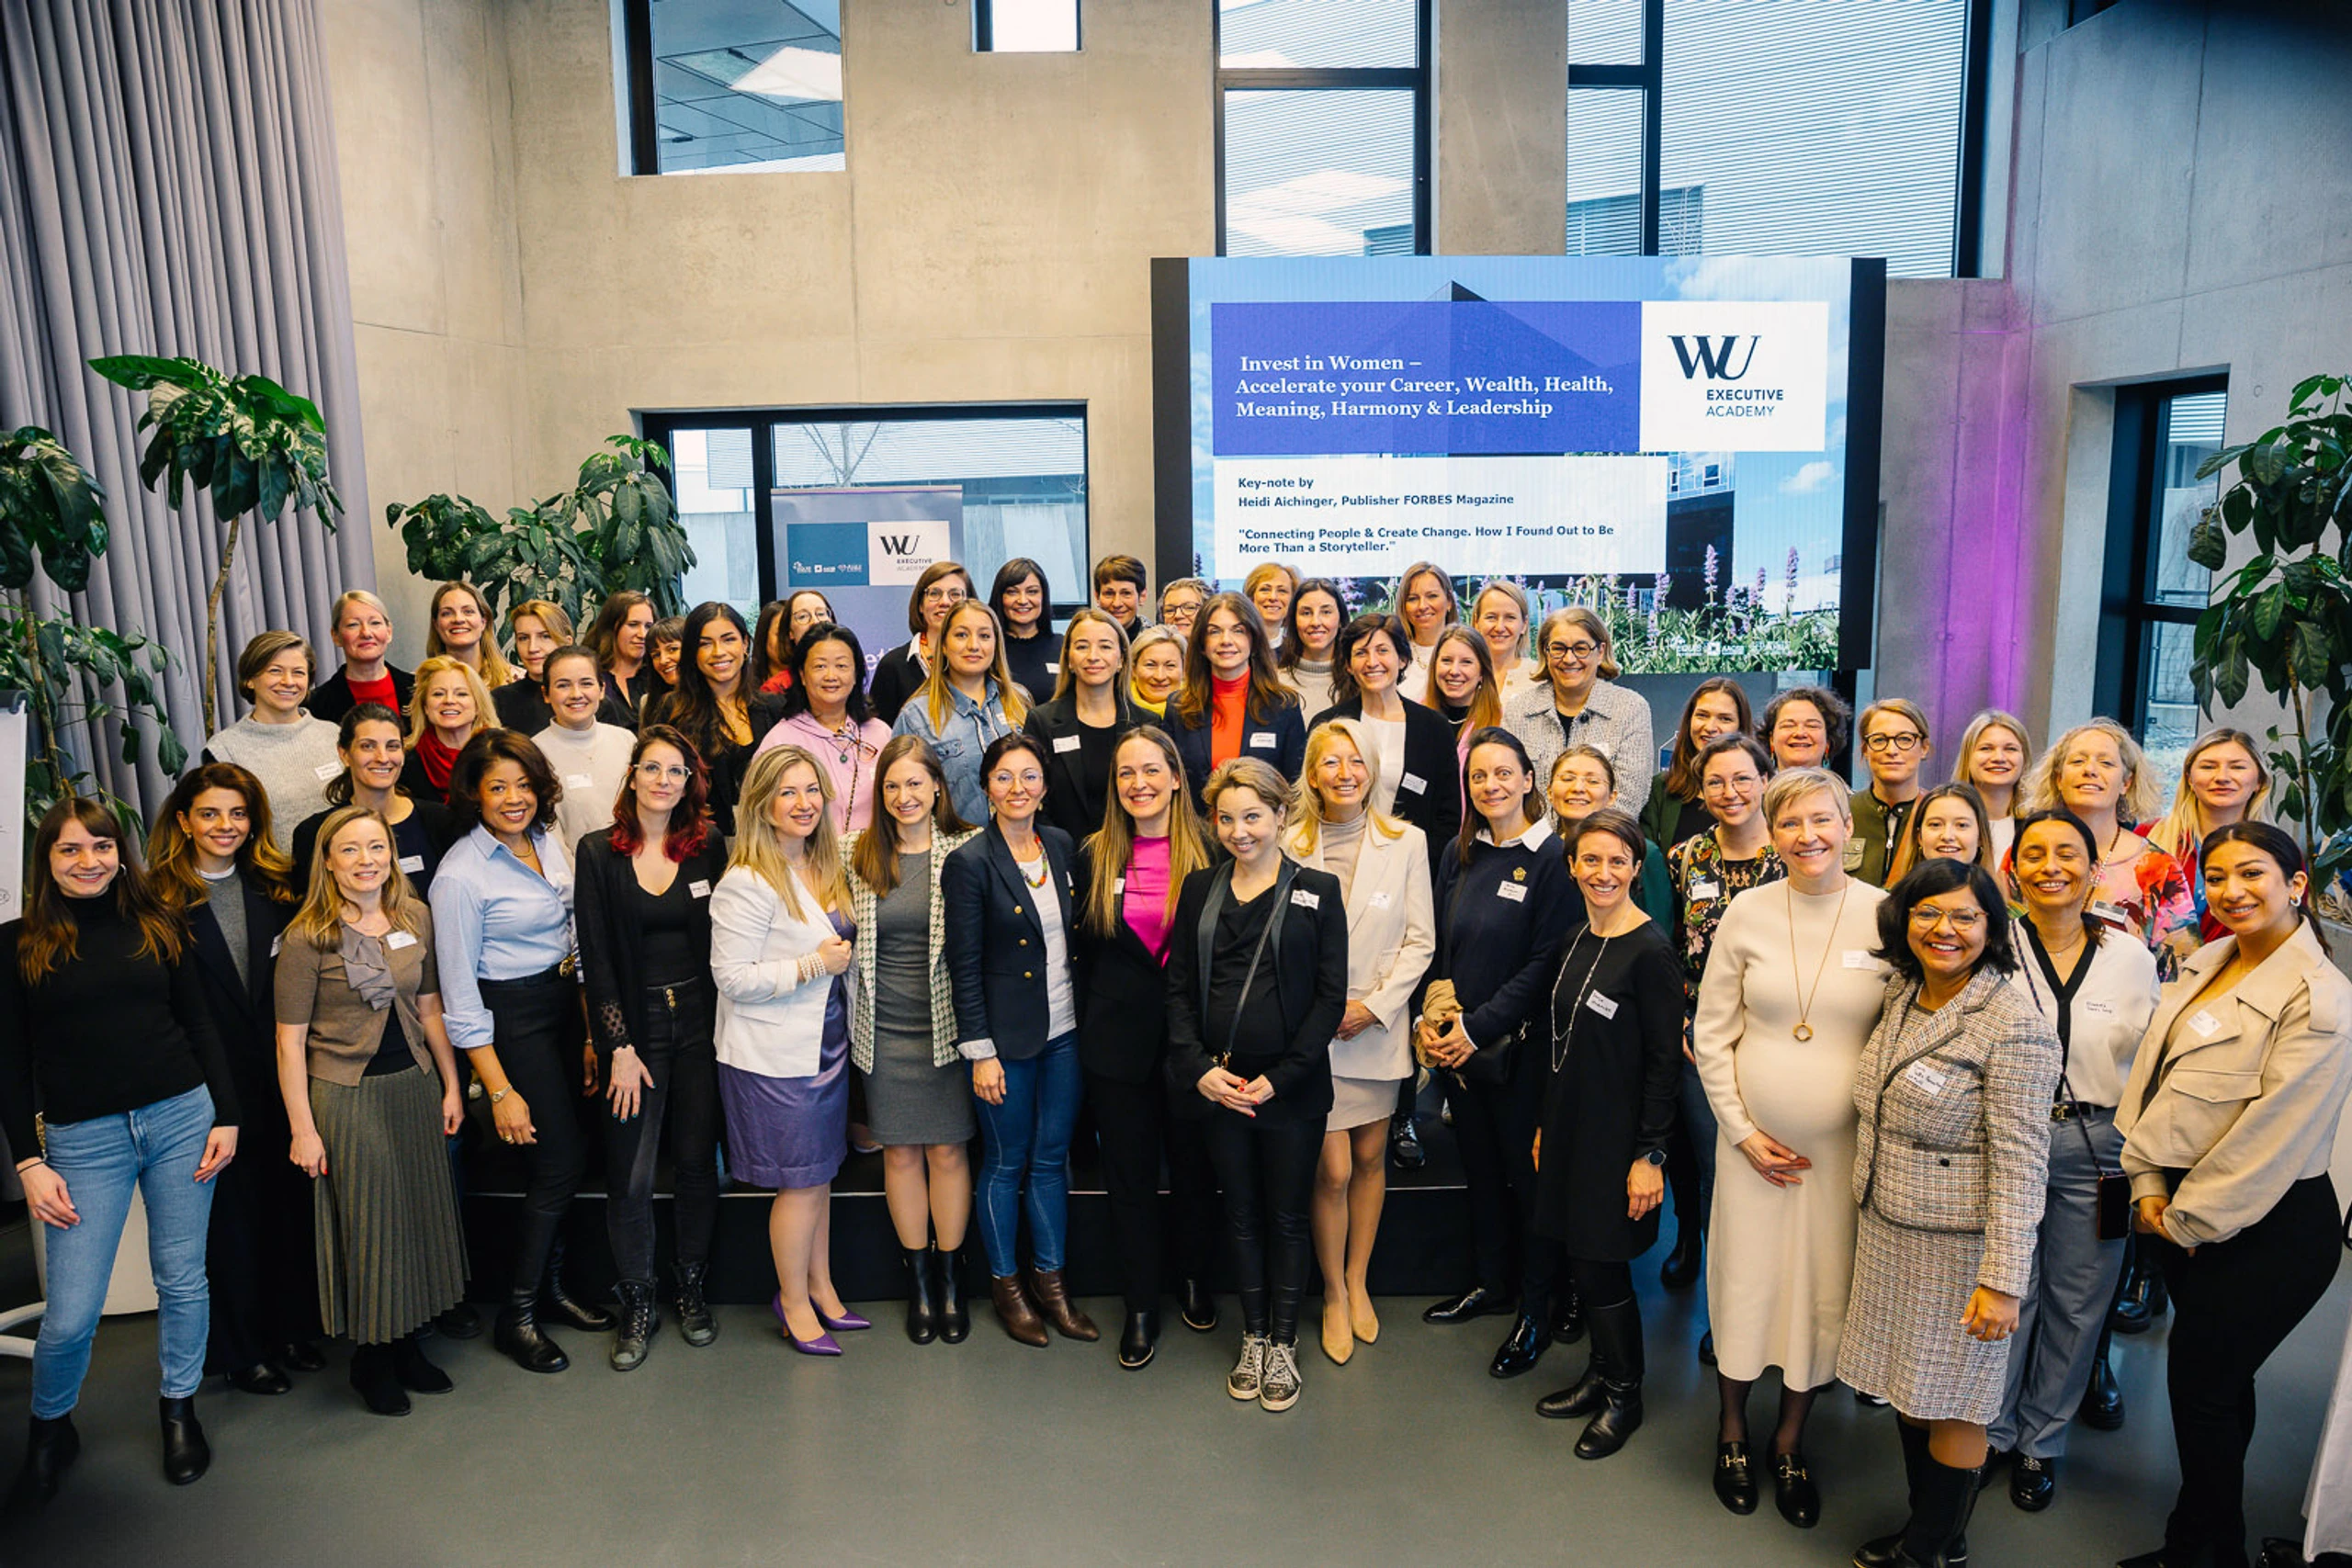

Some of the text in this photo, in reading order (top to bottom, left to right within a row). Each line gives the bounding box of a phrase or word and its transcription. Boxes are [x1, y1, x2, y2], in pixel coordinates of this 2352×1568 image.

[1240, 355, 1301, 372] Invest
[1304, 354, 1325, 371] in
[1328, 355, 1405, 370] Women
[1668, 334, 1761, 381] WU
[1235, 375, 1613, 397] Accelerate your Career, Wealth, Health,
[1706, 389, 1783, 401] EXECUTIVE
[1236, 398, 1554, 420] Meaning, Harmony & Leadership
[1706, 405, 1775, 417] ACADEMY
[1238, 477, 1314, 491] Key-note by
[1238, 493, 1514, 509] Heidi Aichinger, Publisher FORBES Magazine
[1238, 525, 1614, 541] "Connecting People & Create Change. How I Found Out to Be
[879, 535, 921, 556] WU
[1238, 543, 1271, 553] More
[1273, 542, 1304, 553] Than
[1319, 540, 1396, 554] Storyteller."
